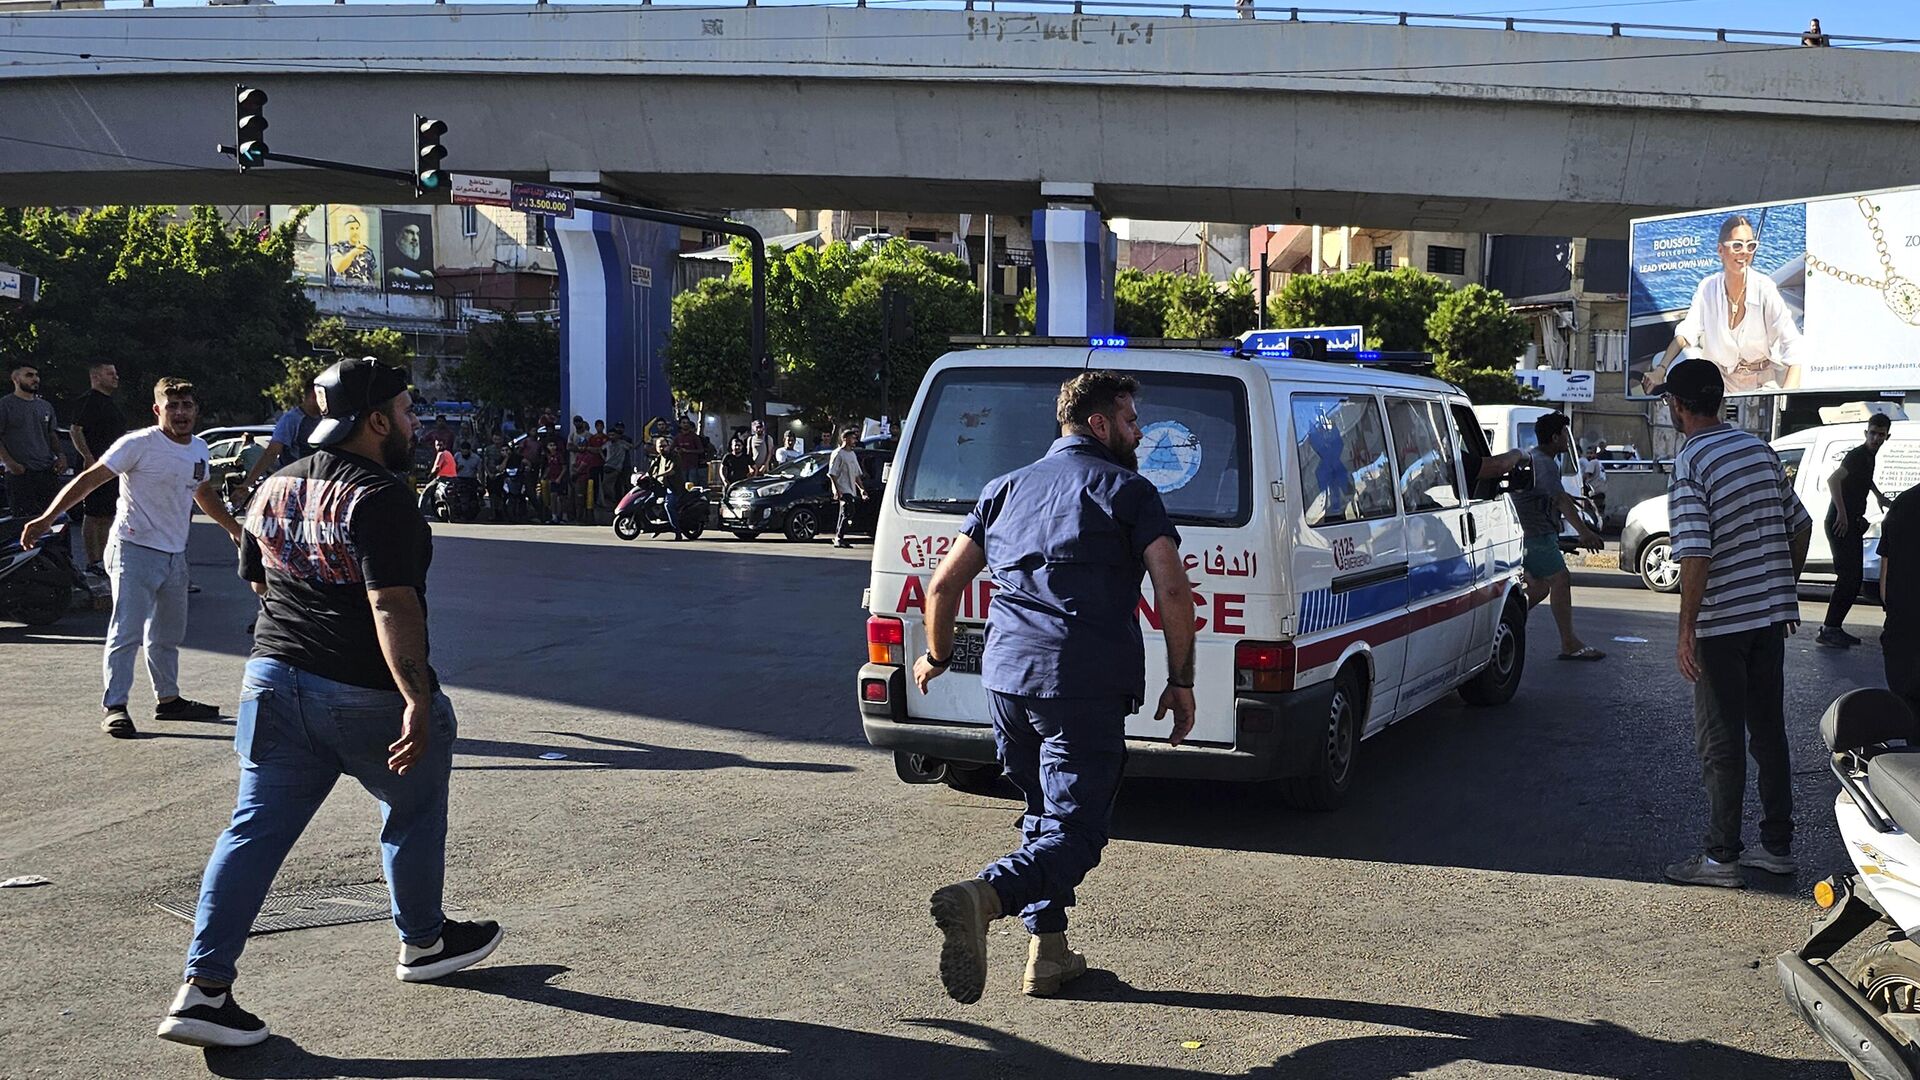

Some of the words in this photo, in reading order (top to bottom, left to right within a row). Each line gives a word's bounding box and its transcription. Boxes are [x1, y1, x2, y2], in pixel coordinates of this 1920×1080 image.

[529, 198, 567, 212] 3.500.000
[1653, 236, 1701, 250] BOUSSOLE
[1657, 247, 1697, 257] COLLECTION
[1639, 264, 1657, 273] LEAD
[1657, 261, 1677, 272] YOUR
[1678, 260, 1696, 270] OWN
[1697, 258, 1714, 268] WAY
[1810, 365, 1824, 373] Shop
[1340, 537, 1354, 557] 125
[1183, 544, 1257, 589] الدفاع
